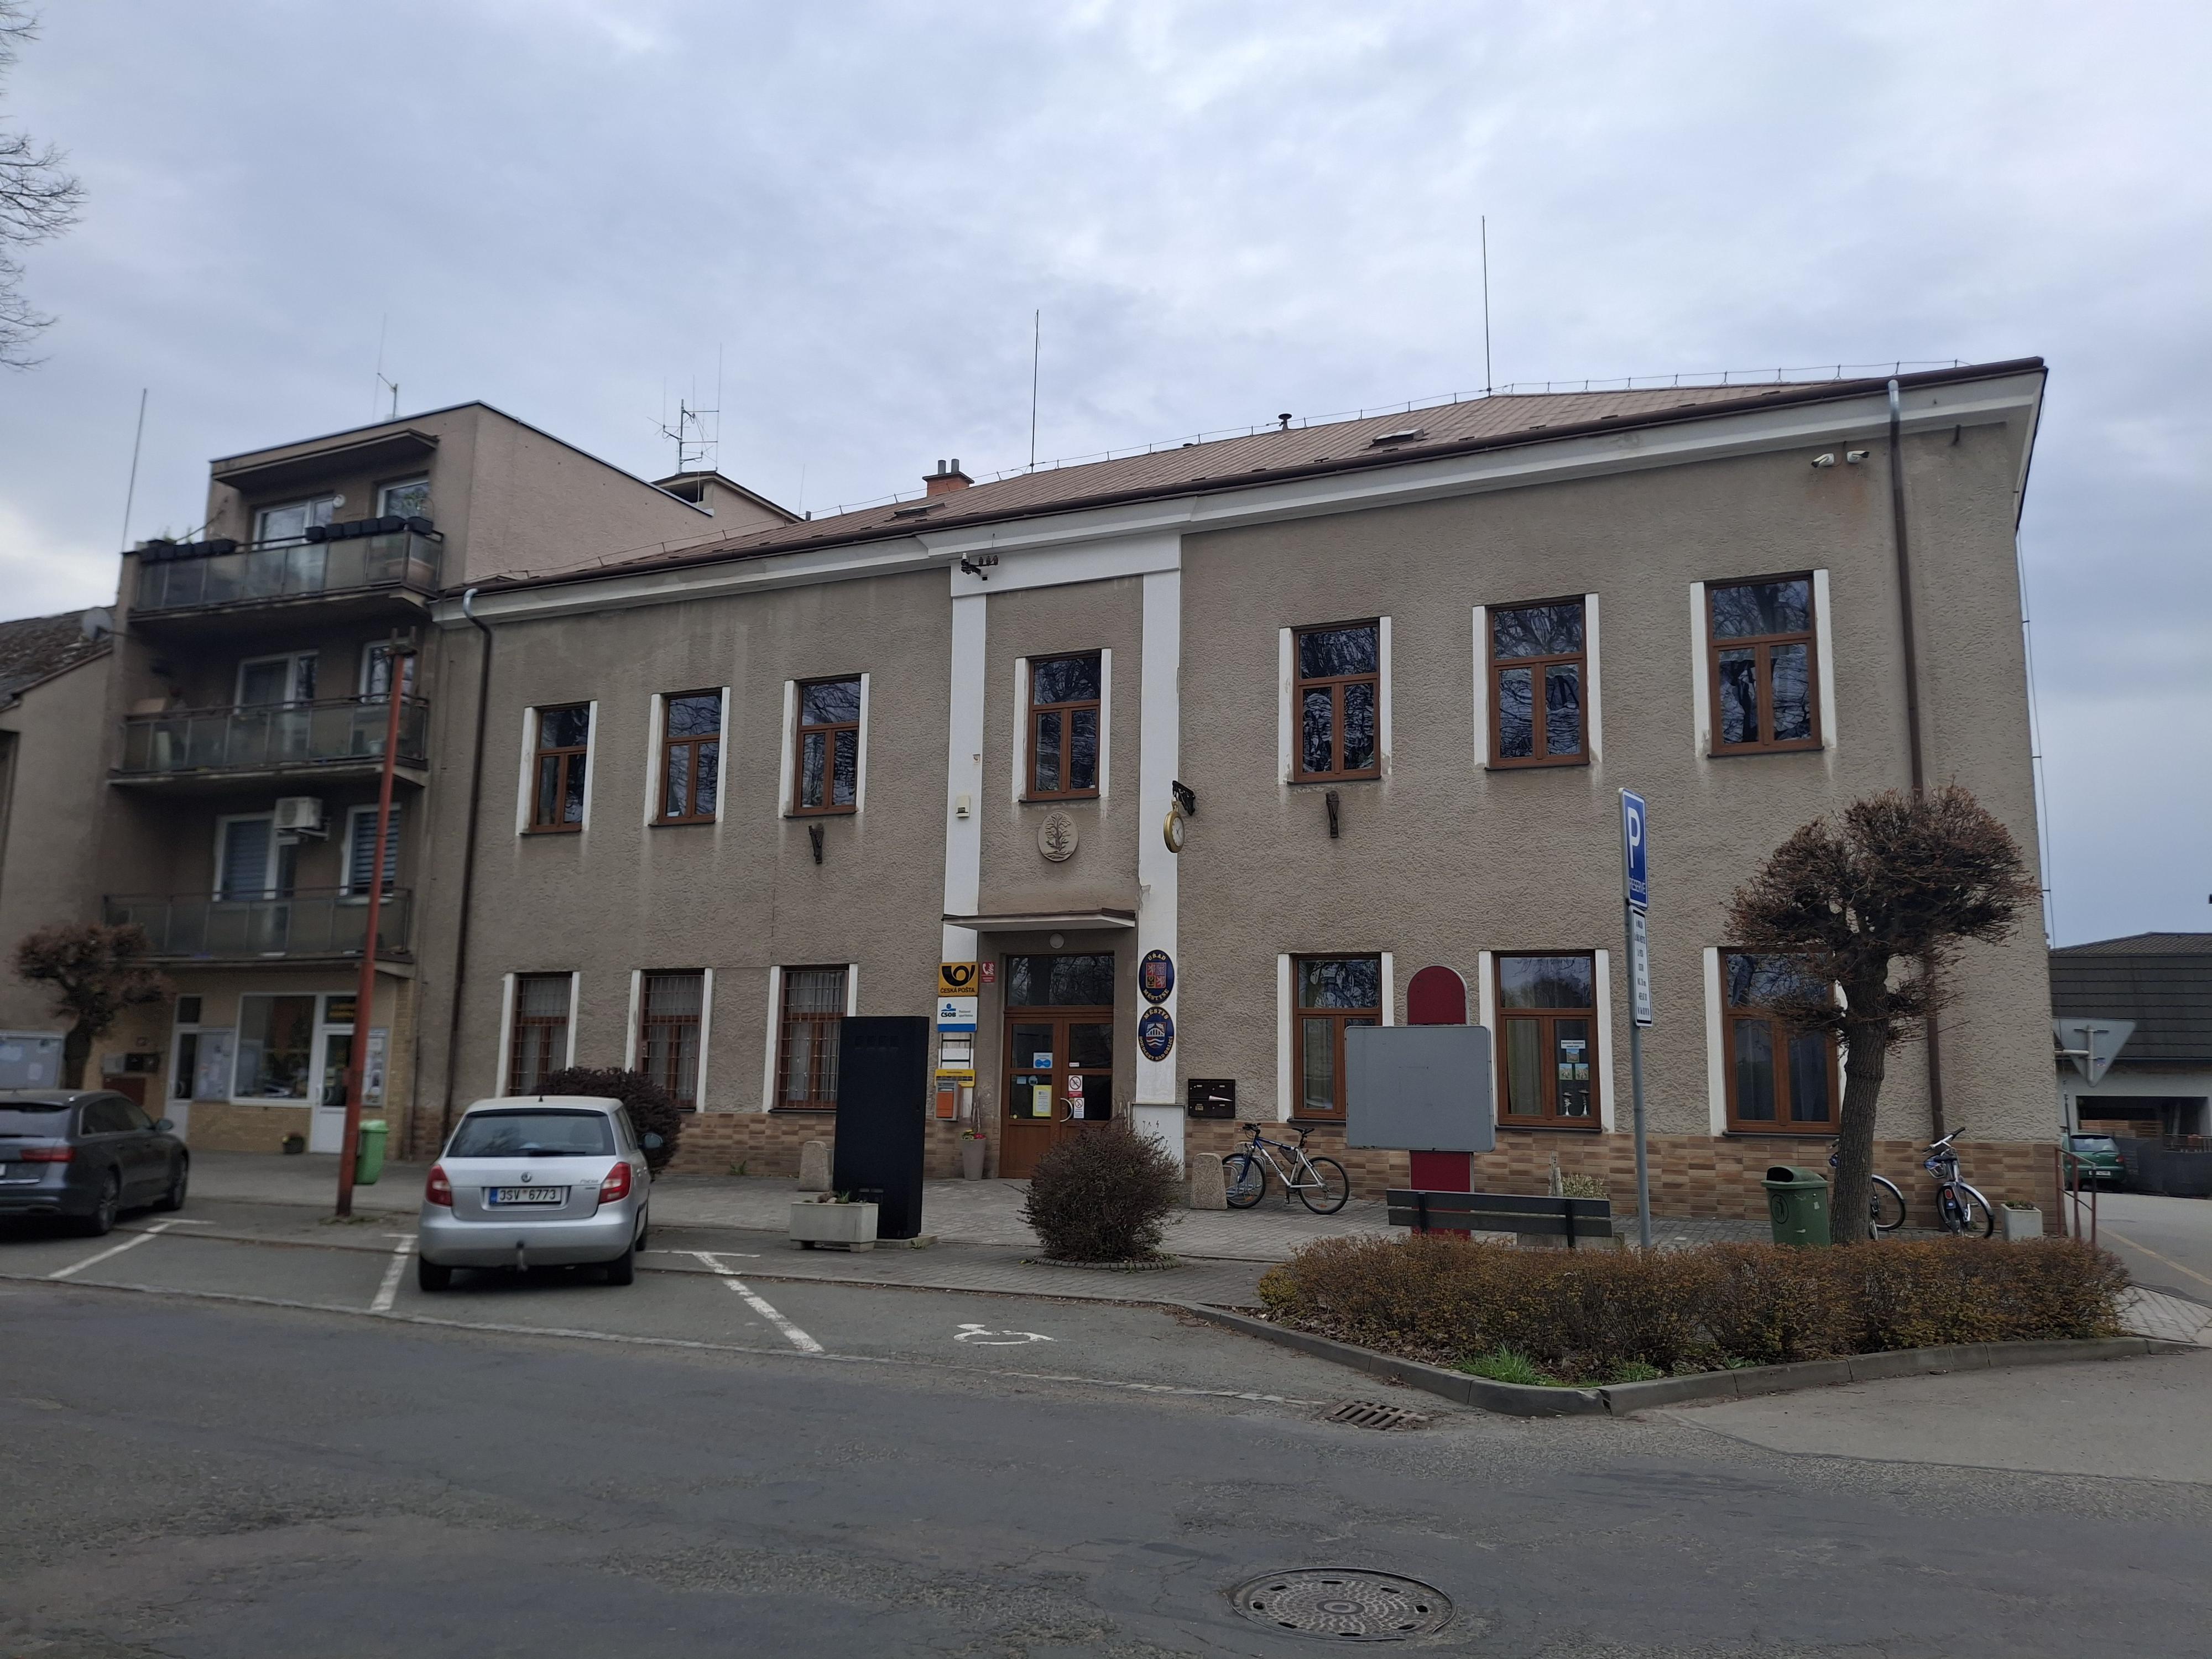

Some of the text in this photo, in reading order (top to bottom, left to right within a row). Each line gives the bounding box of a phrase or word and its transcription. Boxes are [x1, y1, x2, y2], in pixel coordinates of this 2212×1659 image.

[1627, 806, 1641, 868] P
[1629, 875, 1646, 895] RÉSERVÉ
[1147, 952, 1166, 961] ÚŘAD
[1143, 988, 1169, 1000] MĚSTYSE
[1144, 1009, 1169, 1020] MĚSTYS
[499, 1189, 556, 1201] 3SV 6773
